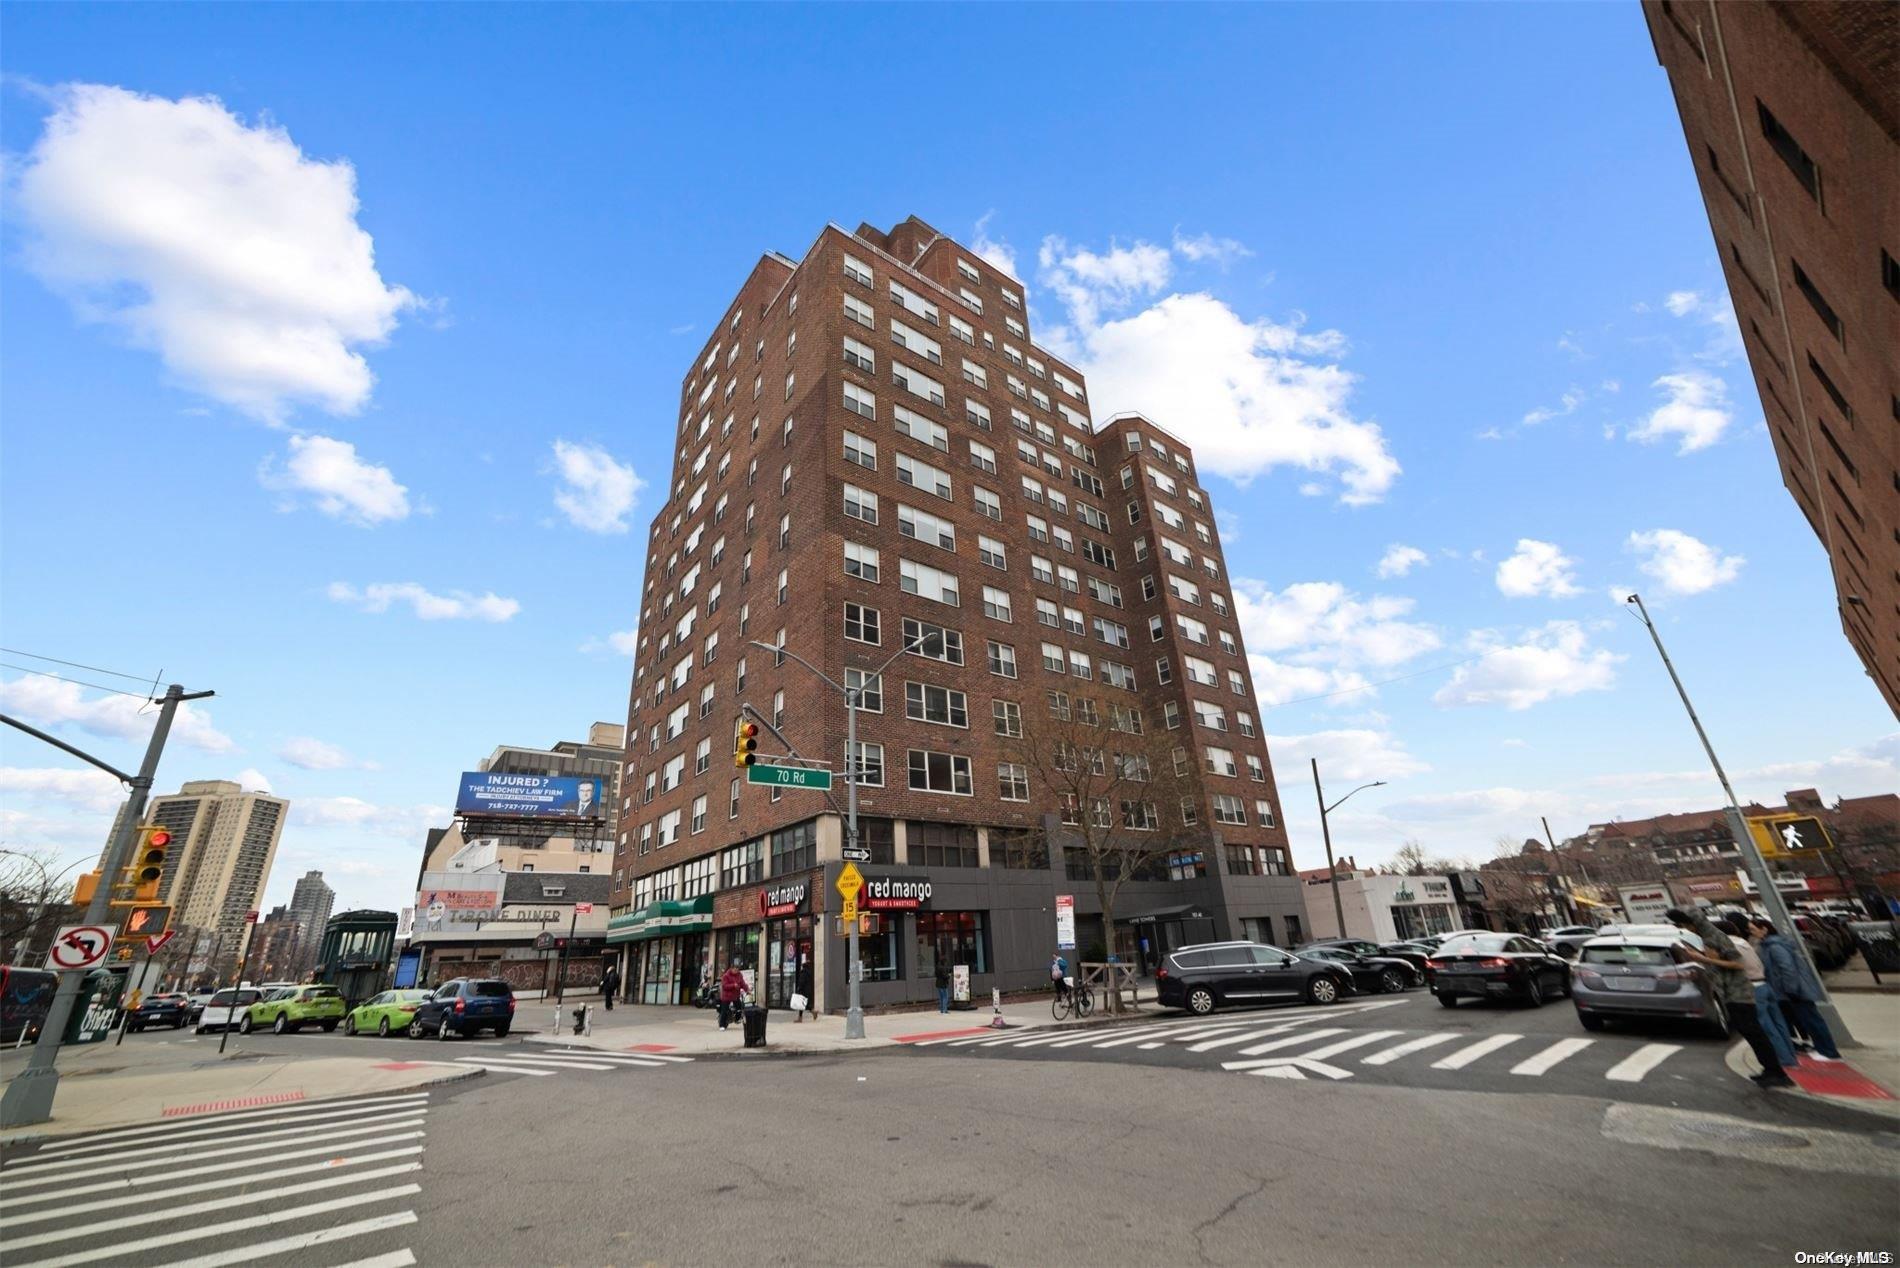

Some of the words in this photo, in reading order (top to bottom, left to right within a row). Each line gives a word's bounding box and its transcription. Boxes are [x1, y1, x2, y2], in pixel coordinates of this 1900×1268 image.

[488, 775, 540, 787] INJURED
[543, 778, 549, 787] ?
[776, 769, 789, 782] 70
[793, 771, 805, 784] Rd
[468, 785, 485, 793] THE
[487, 786, 525, 794] TADCHIEV
[544, 789, 563, 797] FIRM
[767, 885, 780, 907] red
[780, 884, 804, 906] mango
[868, 877, 890, 898] red
[892, 882, 932, 902] mango
[845, 902, 854, 912] 15
[517, 909, 560, 923] DINER
